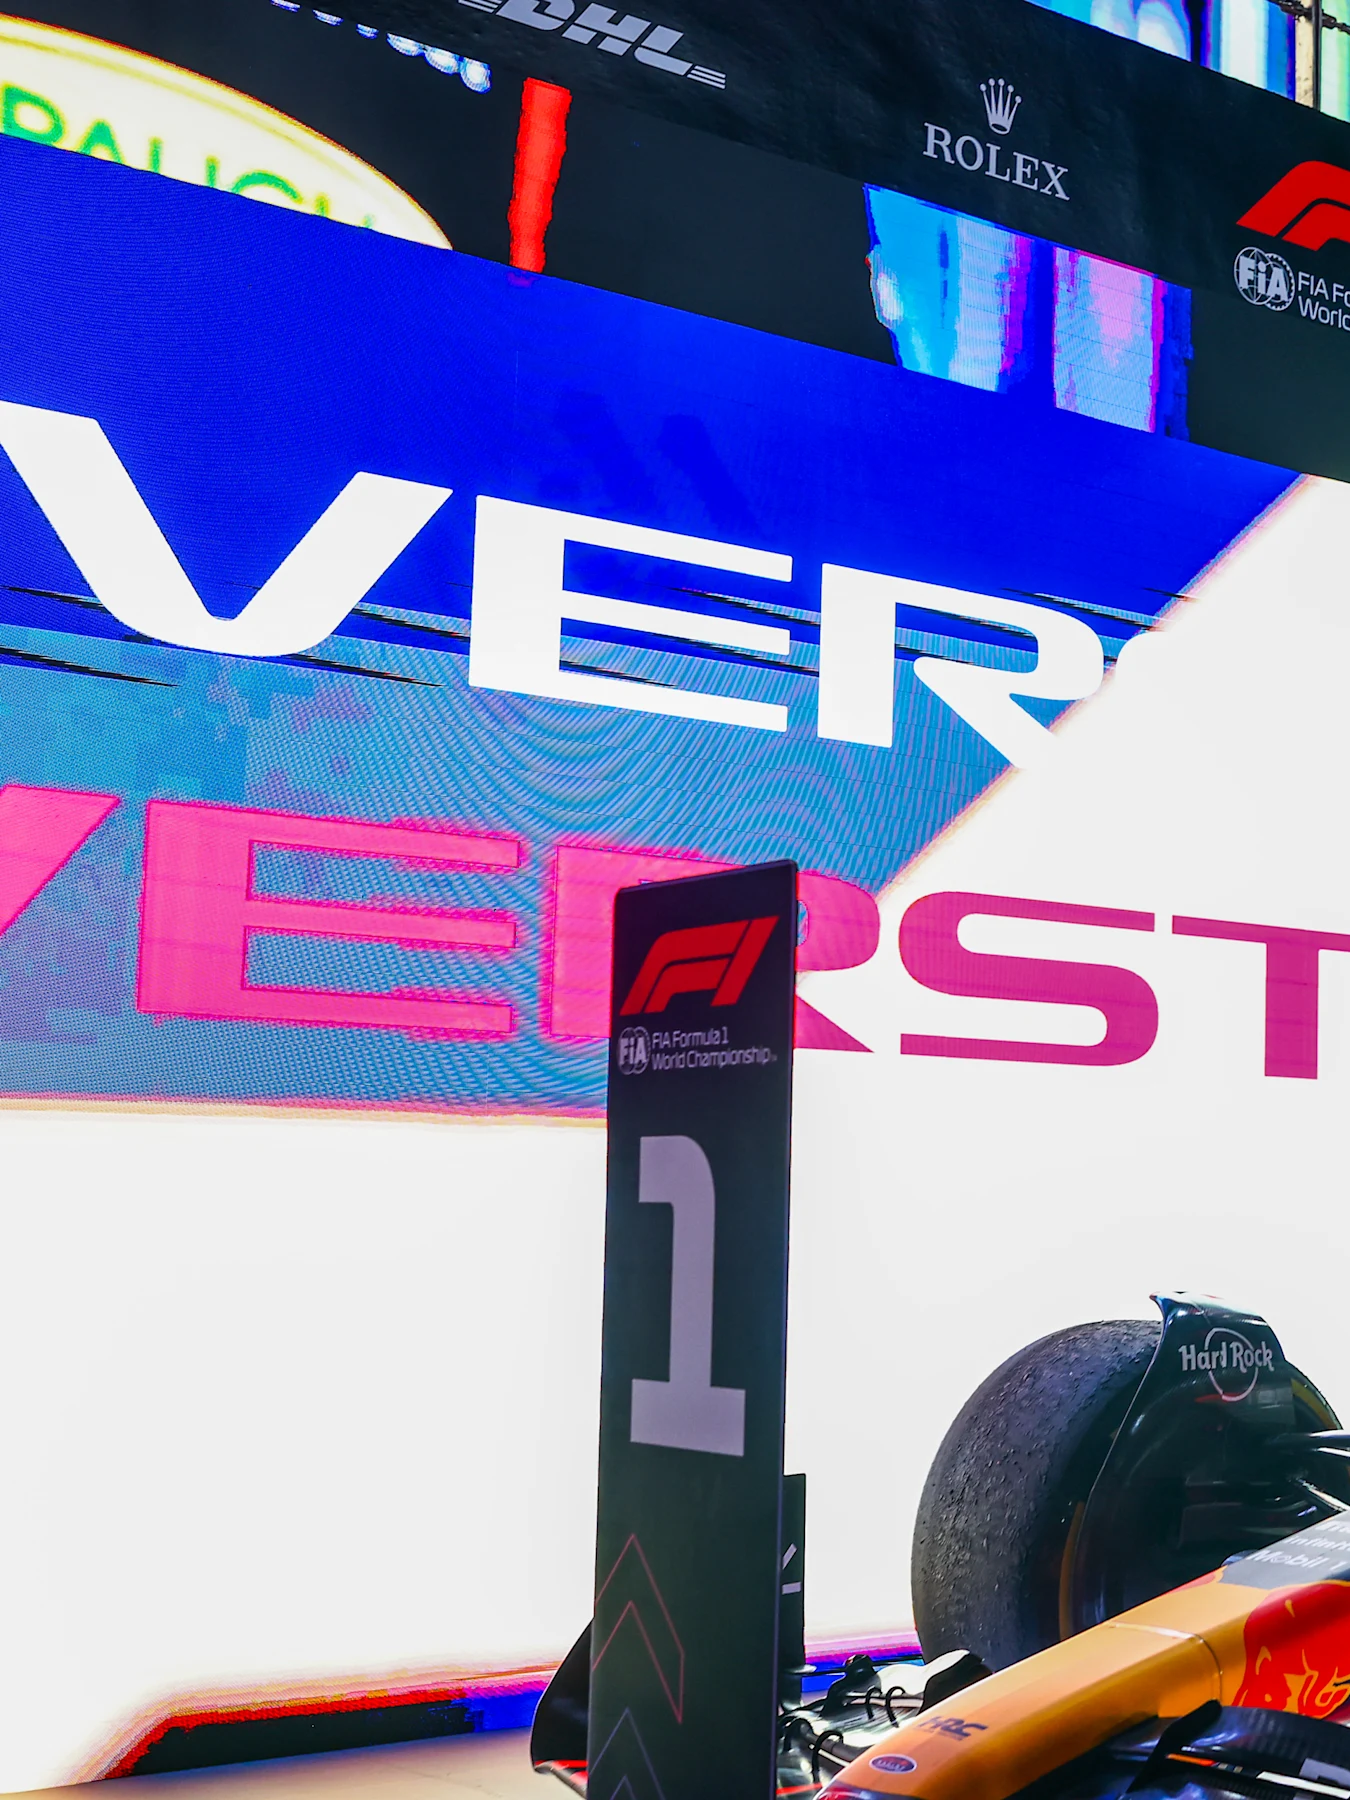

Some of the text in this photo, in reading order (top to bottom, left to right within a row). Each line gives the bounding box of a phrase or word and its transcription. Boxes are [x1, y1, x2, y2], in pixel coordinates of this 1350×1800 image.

[495, 0, 693, 76] DHL
[922, 122, 1070, 201] ROLEX
[1298, 271, 1329, 300] FIA
[619, 915, 779, 1016] F1
[652, 1026, 729, 1049] FIA Formula 1
[652, 1051, 686, 1071] World
[630, 1134, 746, 1456] 1
[1179, 1341, 1275, 1371] Hard Rock
[1248, 1549, 1322, 1569] Mobil
